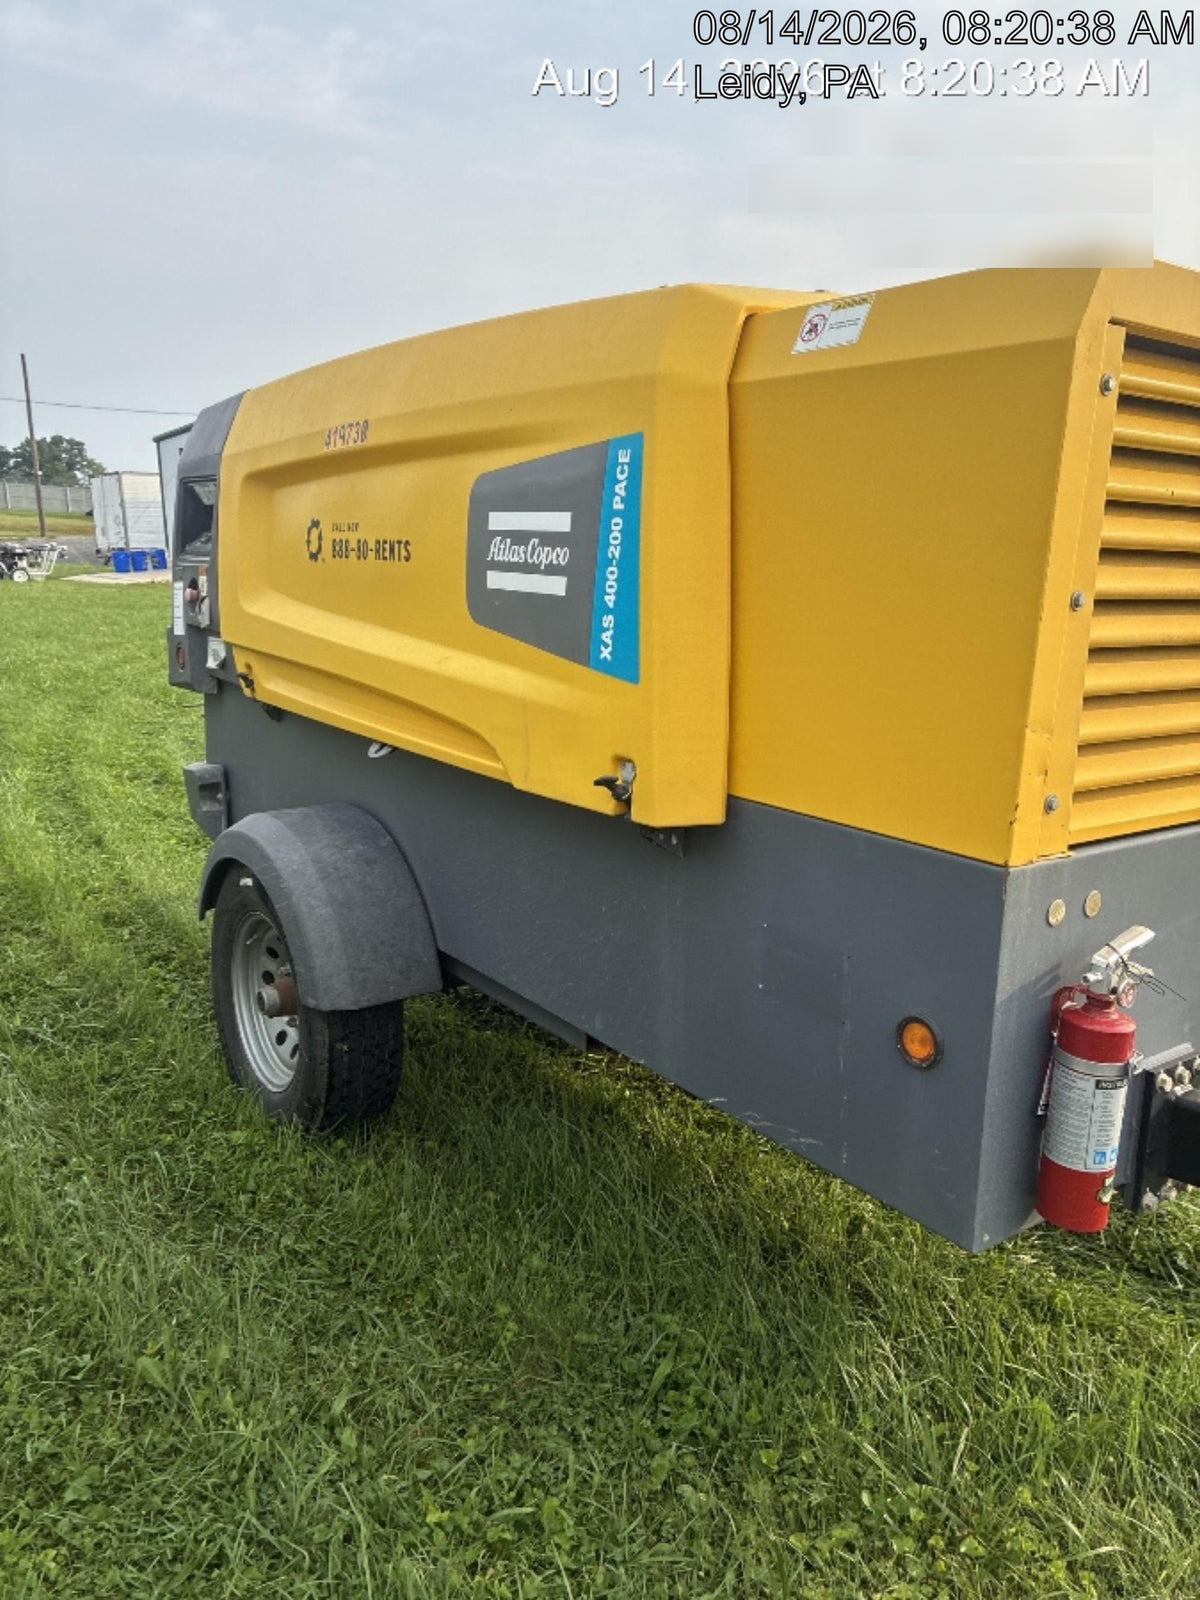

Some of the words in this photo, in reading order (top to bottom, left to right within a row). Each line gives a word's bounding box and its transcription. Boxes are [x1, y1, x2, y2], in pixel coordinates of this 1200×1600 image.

[612, 448, 632, 511] PACE
[486, 536, 527, 563] Atlas
[527, 538, 570, 570] Copco
[604, 516, 624, 609] 400-200
[600, 613, 615, 662] XAS
